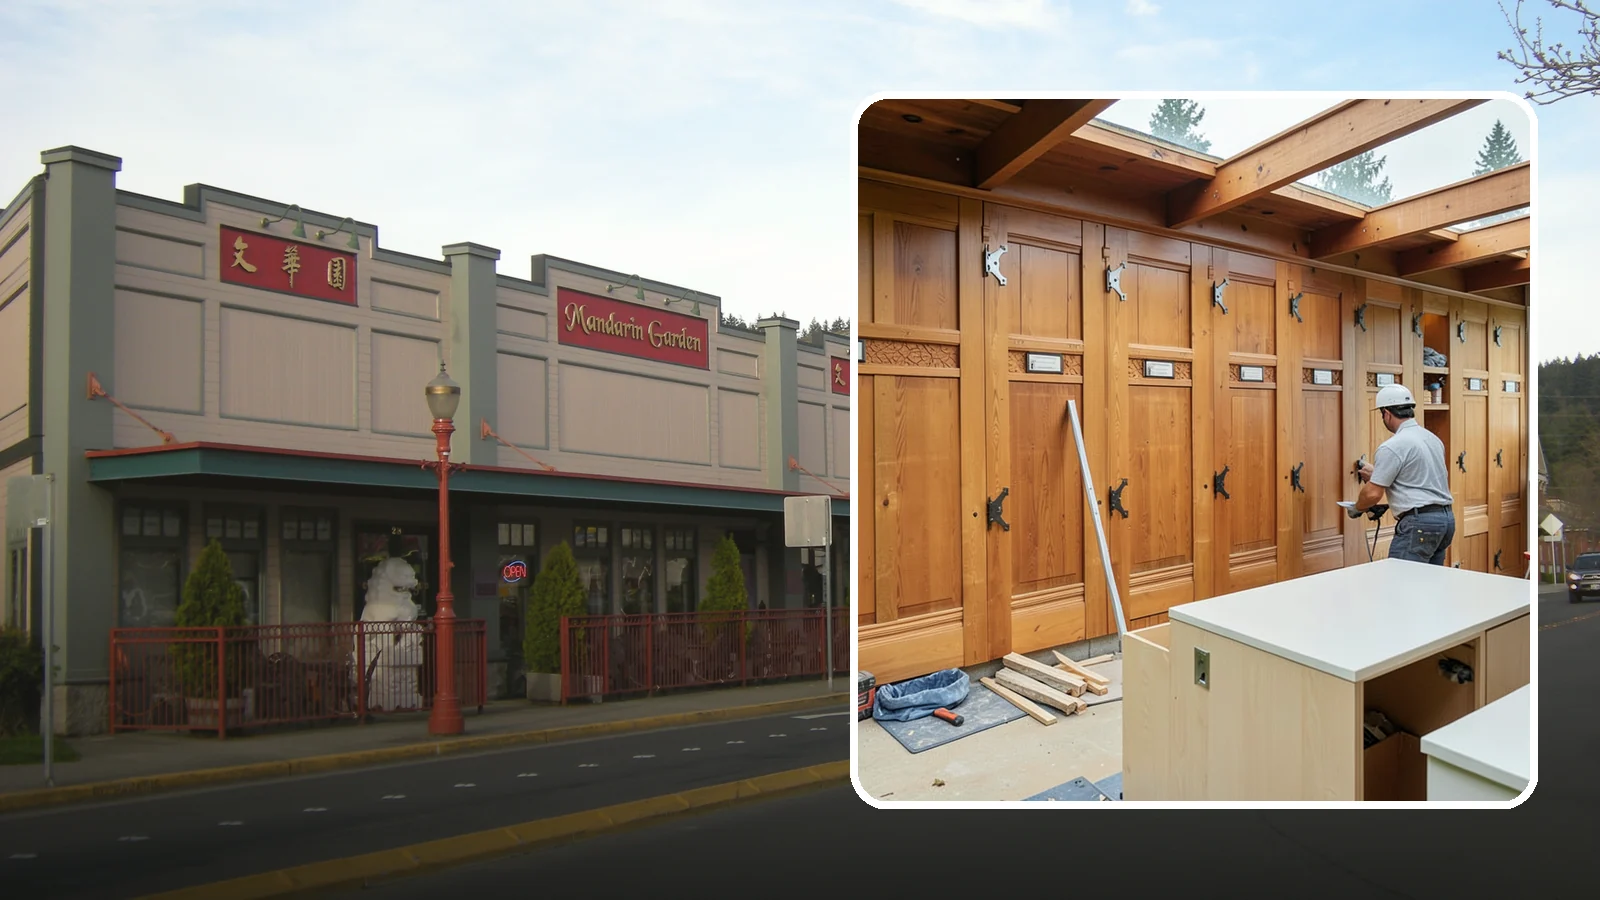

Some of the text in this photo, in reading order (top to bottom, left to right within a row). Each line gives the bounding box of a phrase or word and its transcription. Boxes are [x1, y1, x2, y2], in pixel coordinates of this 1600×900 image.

[231, 236, 346, 290] 文華園
[564, 302, 702, 352] Mandarin Garden
[503, 565, 527, 578] OPEN
